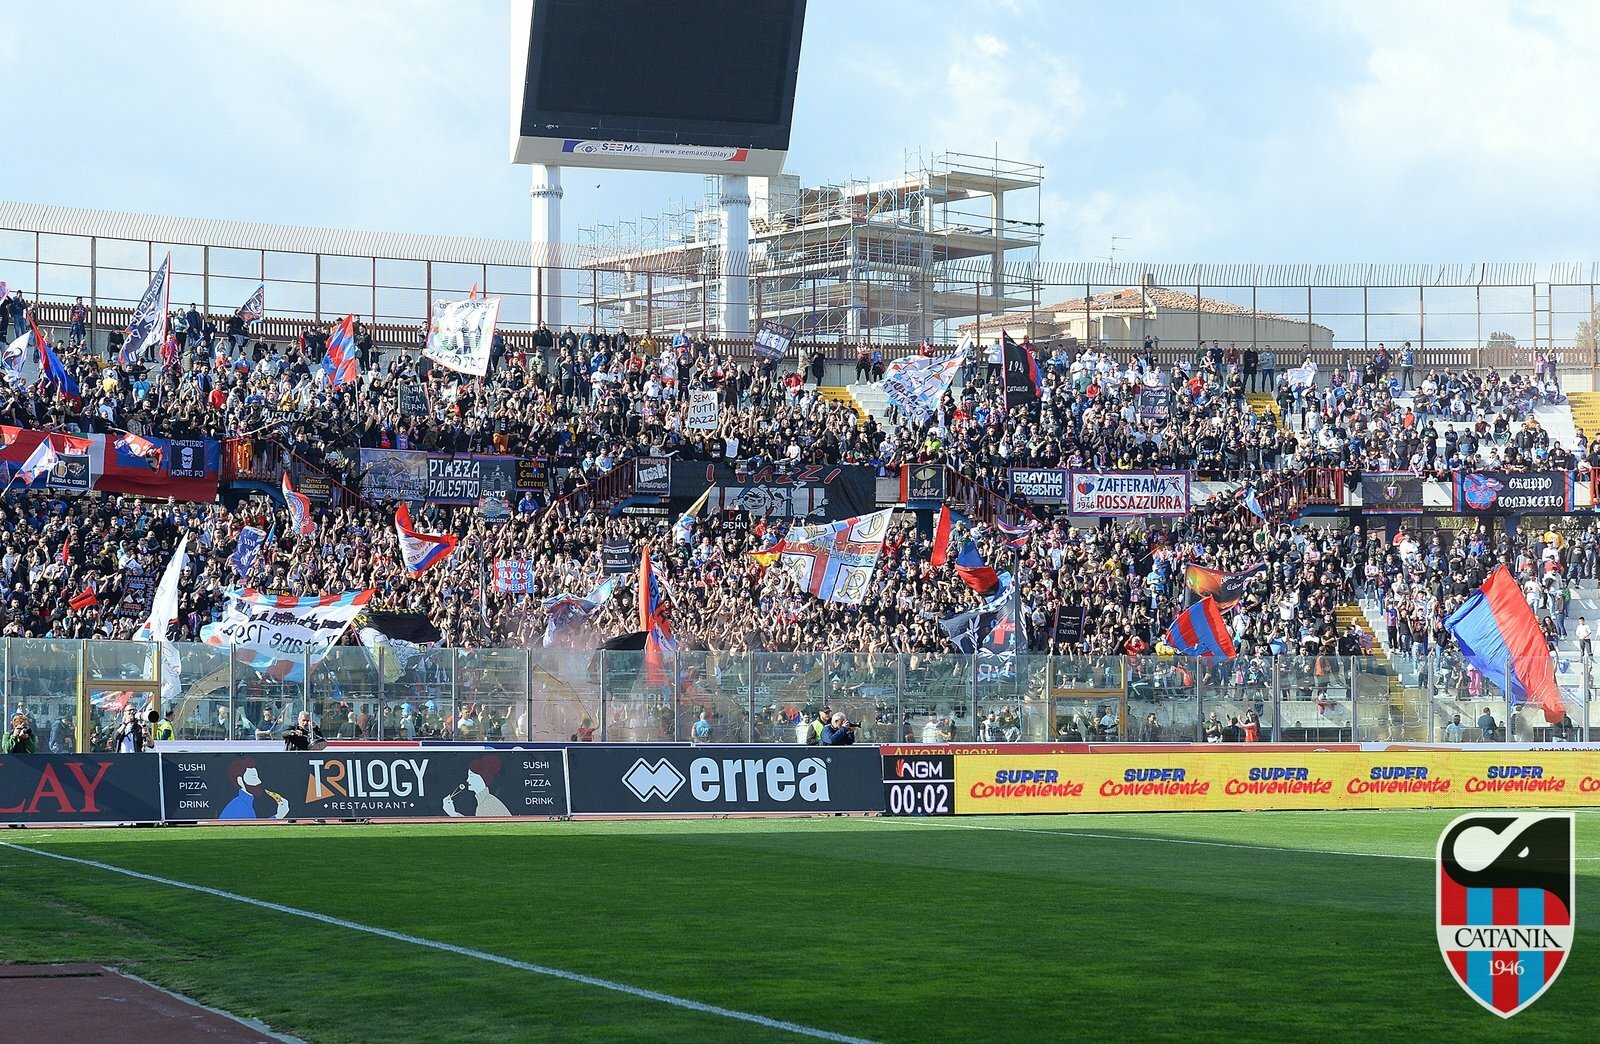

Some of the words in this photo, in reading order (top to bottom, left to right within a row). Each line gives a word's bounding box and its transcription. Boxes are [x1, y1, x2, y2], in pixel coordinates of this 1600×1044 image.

[601, 142, 648, 152] SEEMAX
[659, 148, 735, 159] www.seemaxdisplay.it
[691, 402, 716, 414] TUTTI
[690, 414, 717, 426] PAZZI
[170, 440, 204, 448] QUARTIERE
[429, 459, 480, 479] PIAZZA
[1013, 471, 1063, 484] GRAVINA
[1508, 477, 1552, 491] GRUPPO
[428, 479, 480, 498] PALESTRO
[1097, 477, 1167, 494] ZAFFERANA
[1077, 501, 1095, 509] 1946
[1096, 495, 1182, 510] ROSSAZZURRA
[178, 763, 206, 772] SUSHI
[523, 761, 550, 769] SUSHI
[898, 758, 943, 778] NGM
[1487, 765, 1544, 779] SUPER
[308, 759, 429, 798] TRILOGY
[995, 769, 1059, 784] SUPER
[1124, 767, 1186, 782] SUPER
[1249, 767, 1309, 781] SUPER
[1370, 766, 1428, 780] SUPER
[179, 781, 208, 790] PIZZA
[524, 779, 552, 787] PIZZA
[969, 780, 1084, 799] Conveniente
[1099, 779, 1210, 797] Conveniente
[1224, 778, 1332, 796] Conveniente
[1346, 777, 1451, 795] Conveniente
[1464, 776, 1566, 793] Conveniente
[179, 800, 209, 809] DRINK
[331, 801, 408, 810] RESTAURANT
[525, 797, 554, 805] DRINK
[889, 784, 949, 814] 00:02
